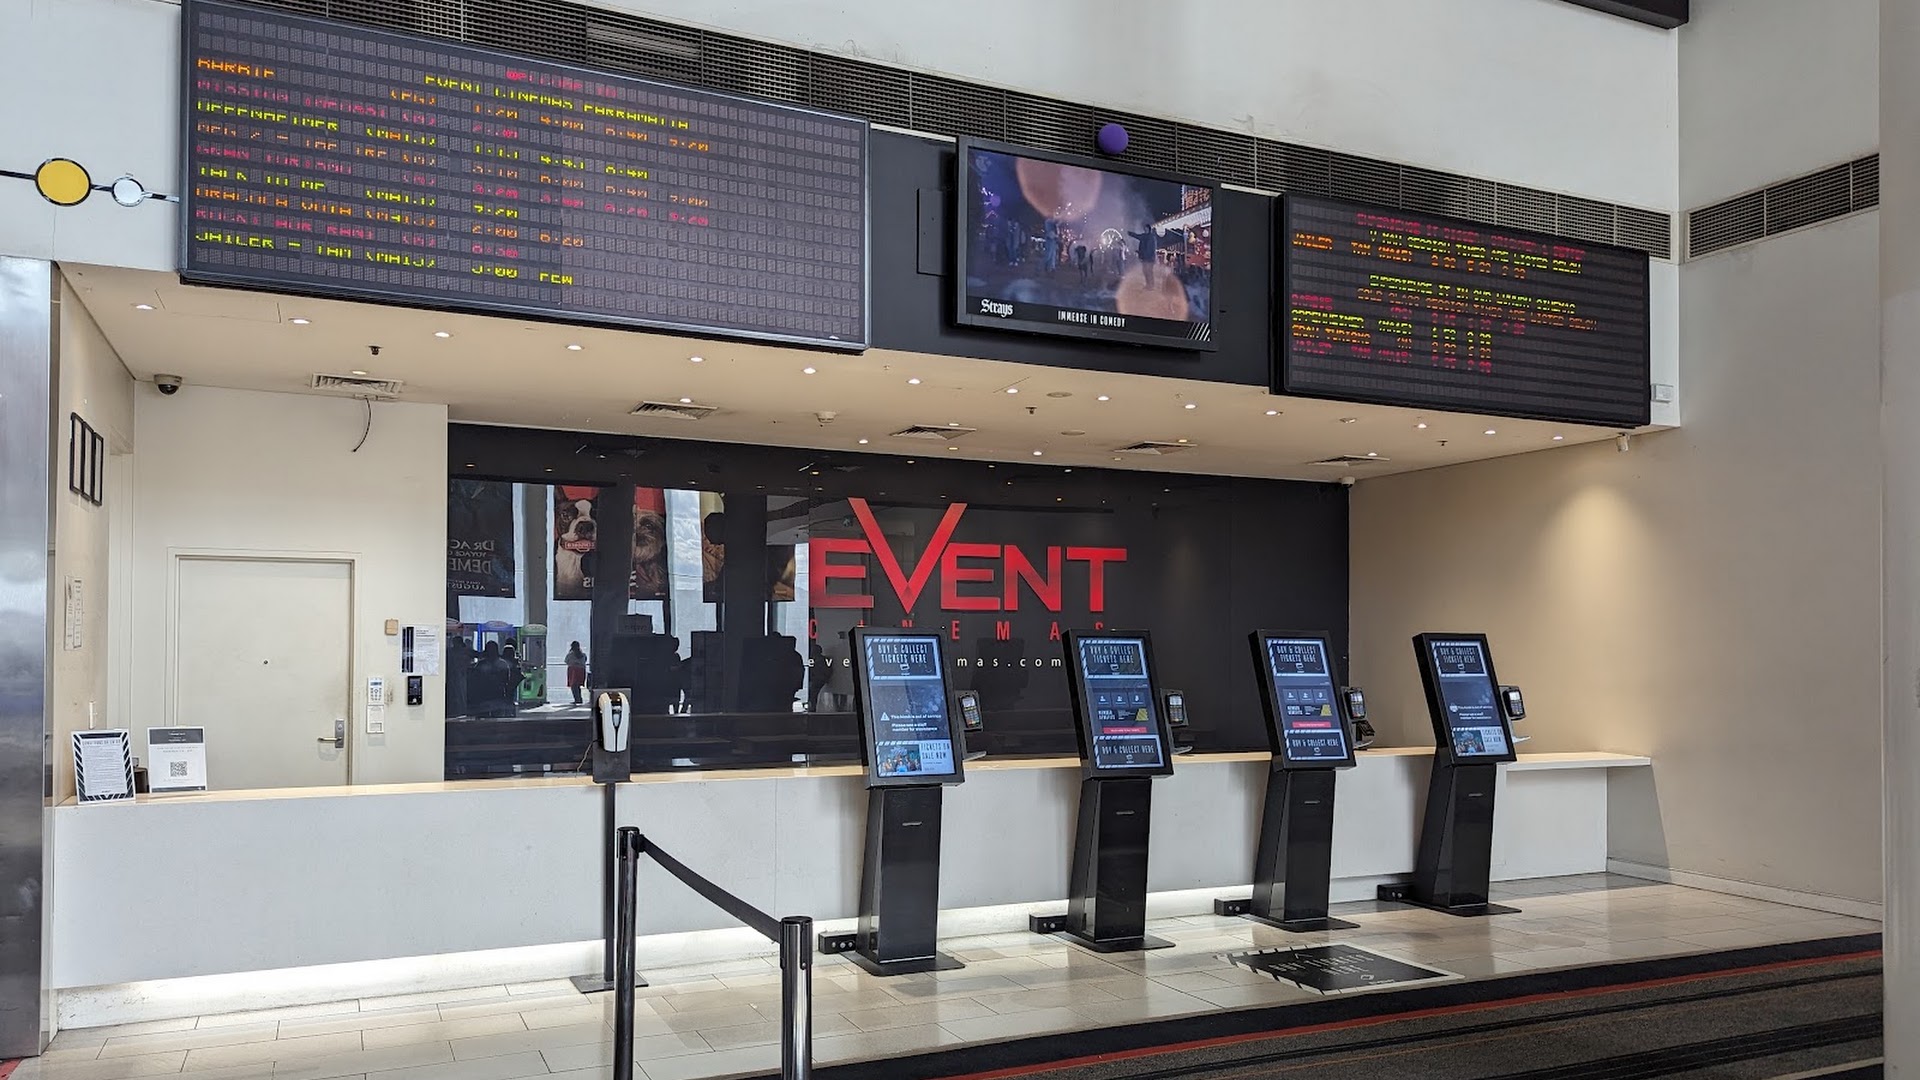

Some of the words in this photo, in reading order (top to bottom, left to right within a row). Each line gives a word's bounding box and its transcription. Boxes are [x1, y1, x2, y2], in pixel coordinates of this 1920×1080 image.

[980, 298, 1014, 319] Strays
[1057, 310, 1088, 324] IMMERSE
[1090, 314, 1098, 325] IN
[1100, 315, 1126, 328] COMEDY
[809, 497, 1127, 615] EVENT
[900, 644, 928, 654] COLLECT
